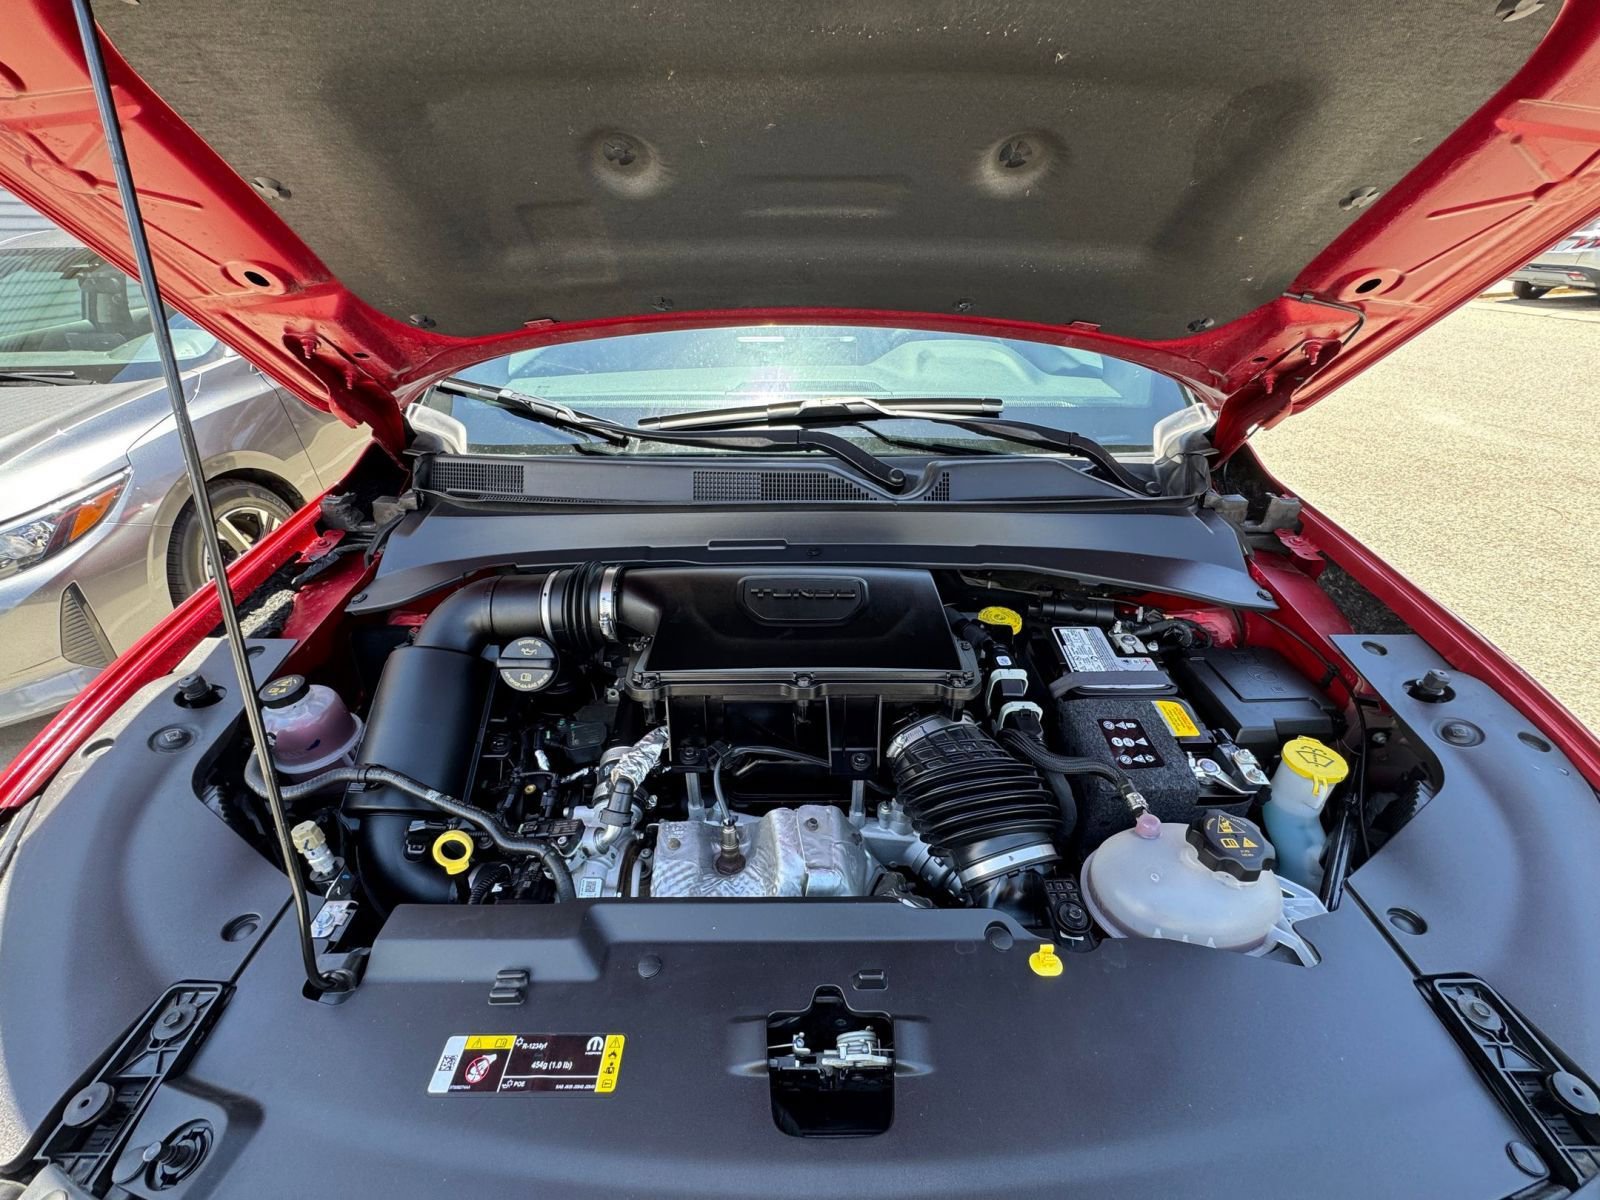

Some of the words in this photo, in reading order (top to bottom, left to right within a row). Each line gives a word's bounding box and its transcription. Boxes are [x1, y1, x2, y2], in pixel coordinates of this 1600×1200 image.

[750, 587, 856, 598] TURBO
[522, 1041, 548, 1050] R-1234yf
[531, 1061, 548, 1070] 454g
[548, 1061, 562, 1070] (1.0
[562, 1061, 573, 1070] lb)
